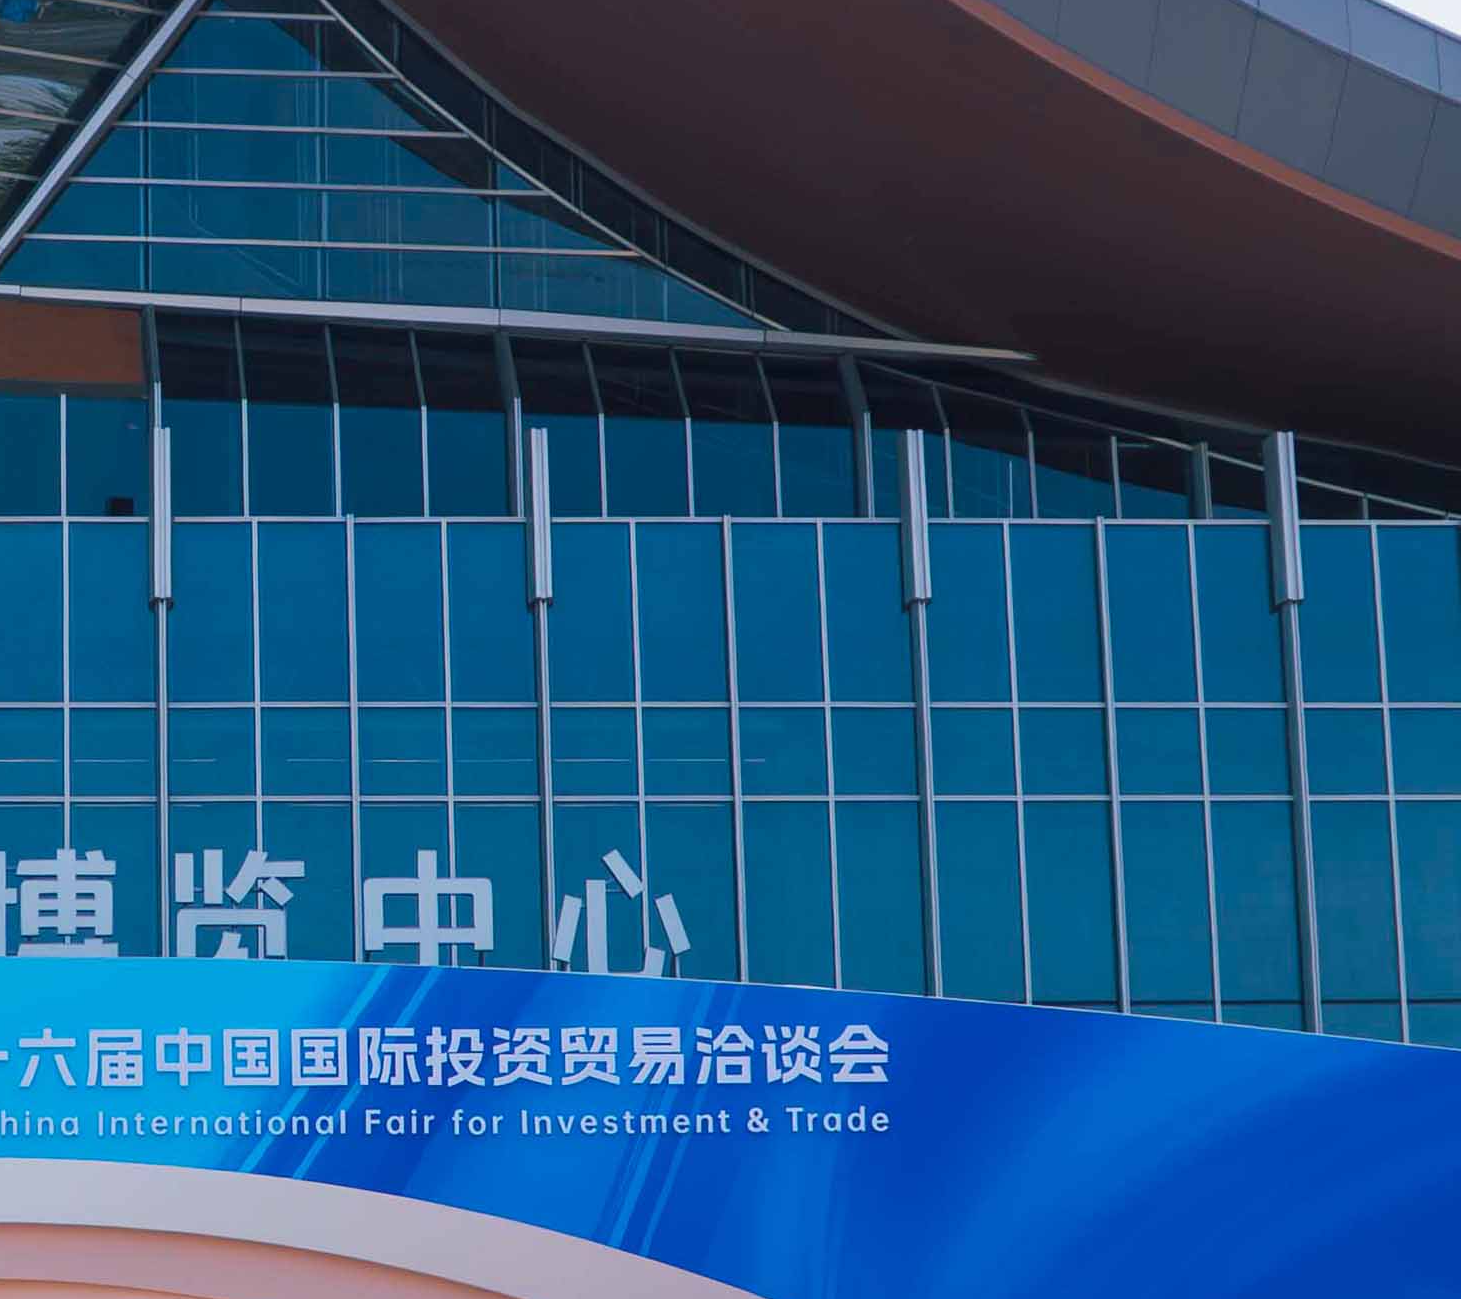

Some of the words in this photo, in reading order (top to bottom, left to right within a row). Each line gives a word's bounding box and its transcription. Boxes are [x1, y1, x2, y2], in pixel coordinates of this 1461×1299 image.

[98, 1109, 346, 1136] International
[365, 1108, 435, 1135] Fair
[452, 1108, 504, 1135] for
[521, 1109, 731, 1135] Investment
[747, 1107, 770, 1133] &
[786, 1105, 890, 1133] Trade
